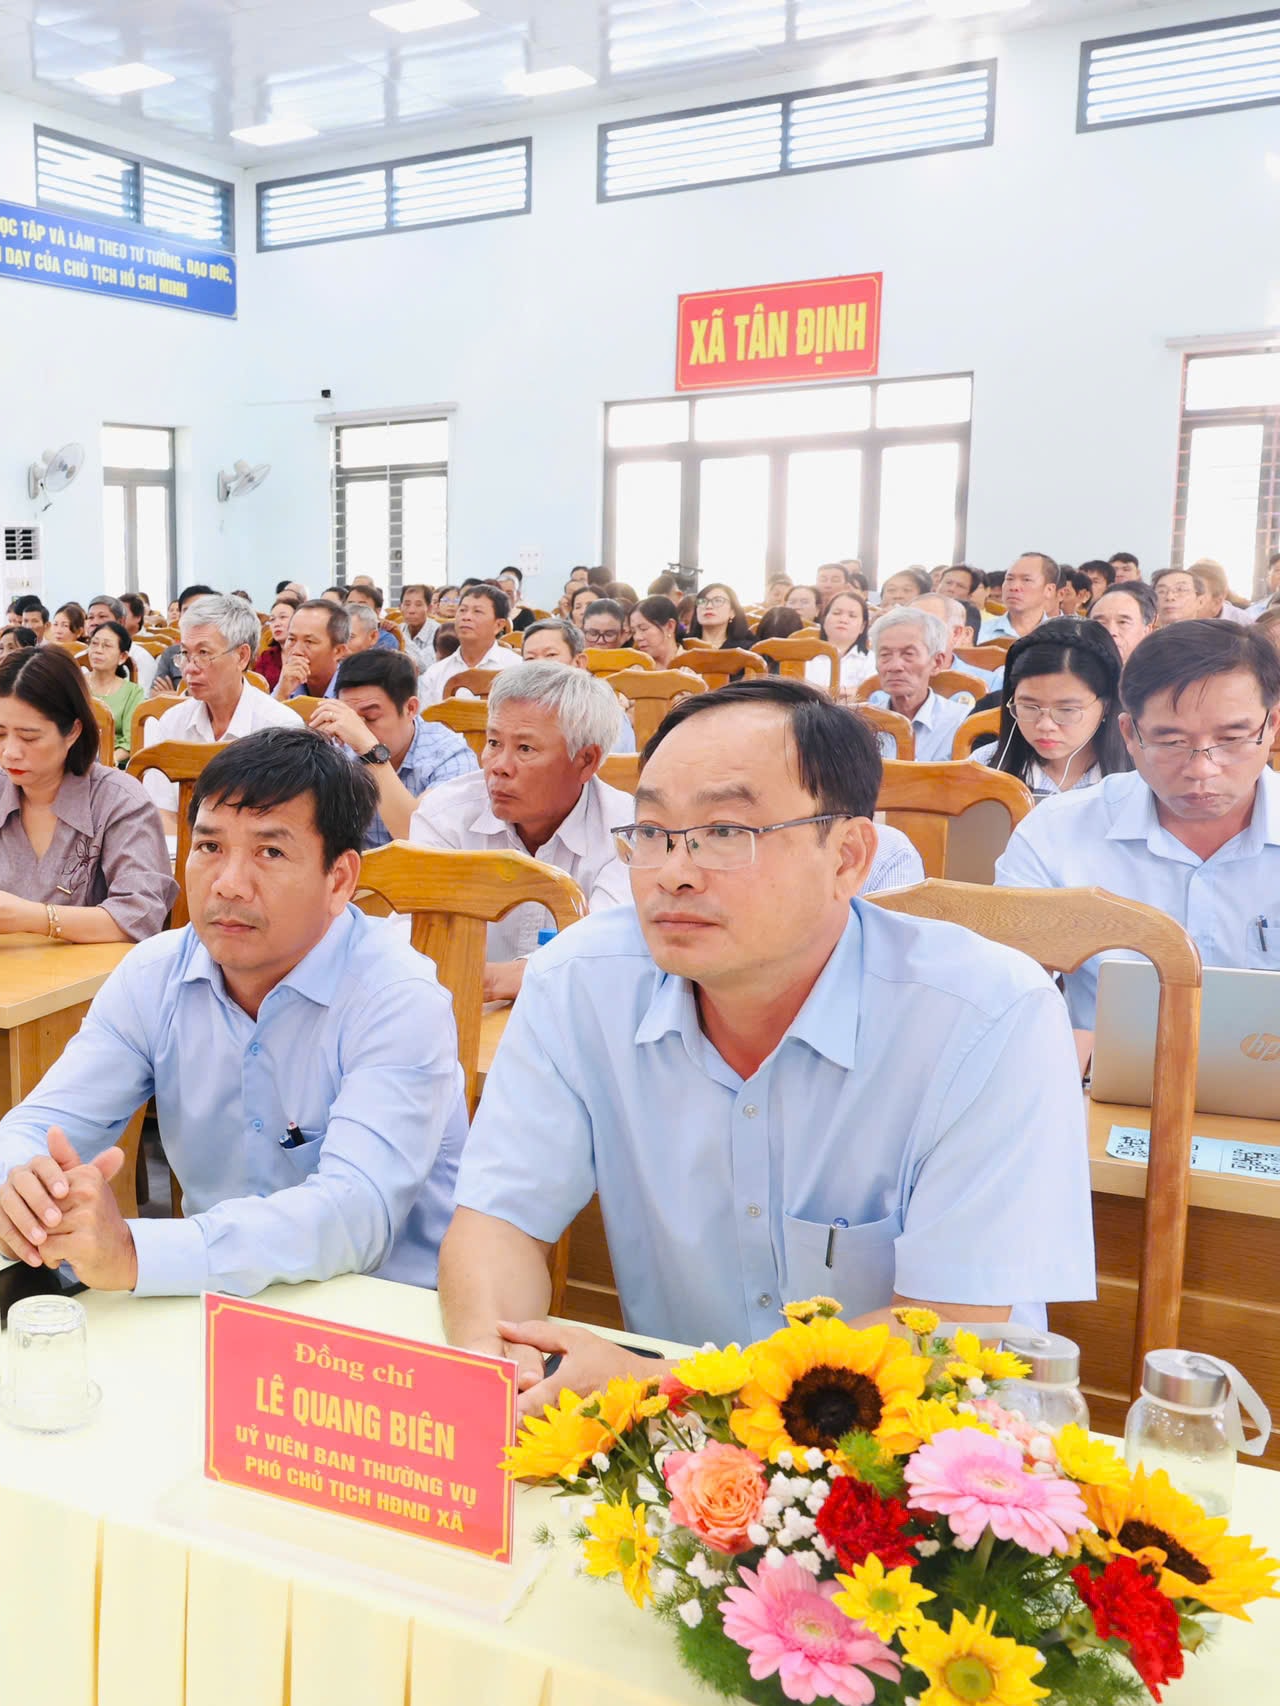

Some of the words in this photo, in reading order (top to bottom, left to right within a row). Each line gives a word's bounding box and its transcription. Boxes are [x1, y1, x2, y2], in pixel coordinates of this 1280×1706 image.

[5, 247, 30, 271] DẠY
[35, 250, 61, 274] CỦA
[64, 257, 89, 279] CHỦ
[91, 263, 117, 286] TỊCH
[138, 273, 157, 292] CHÍ
[159, 277, 188, 298] MINH
[21, 220, 46, 244] TẬP
[49, 225, 65, 247] VÀ
[68, 230, 95, 253] LÀM
[97, 238, 127, 260] THEO
[129, 245, 145, 263] TƯ
[186, 258, 208, 279] ĐẠO
[209, 263, 232, 285] ĐỨC,
[689, 308, 726, 365] XÃ
[734, 303, 789, 361] TÂN
[795, 302, 867, 365] ĐỊNH
[294, 1342, 366, 1382] Đồng
[372, 1364, 414, 1389] chí
[256, 1373, 285, 1417] LÊ
[292, 1386, 381, 1442] QUANG
[389, 1410, 455, 1461] BIÊN
[235, 1423, 259, 1447] UỶ
[265, 1433, 308, 1461] VIÊN
[314, 1448, 356, 1473] BAN
[361, 1457, 444, 1498] THƯỜNG
[449, 1481, 478, 1509] VỤ
[245, 1454, 281, 1481] PHÓ
[286, 1467, 324, 1492] CHỦ
[329, 1479, 371, 1506] TỊCH
[376, 1490, 431, 1523] HĐND
[436, 1508, 464, 1533] XÃ
